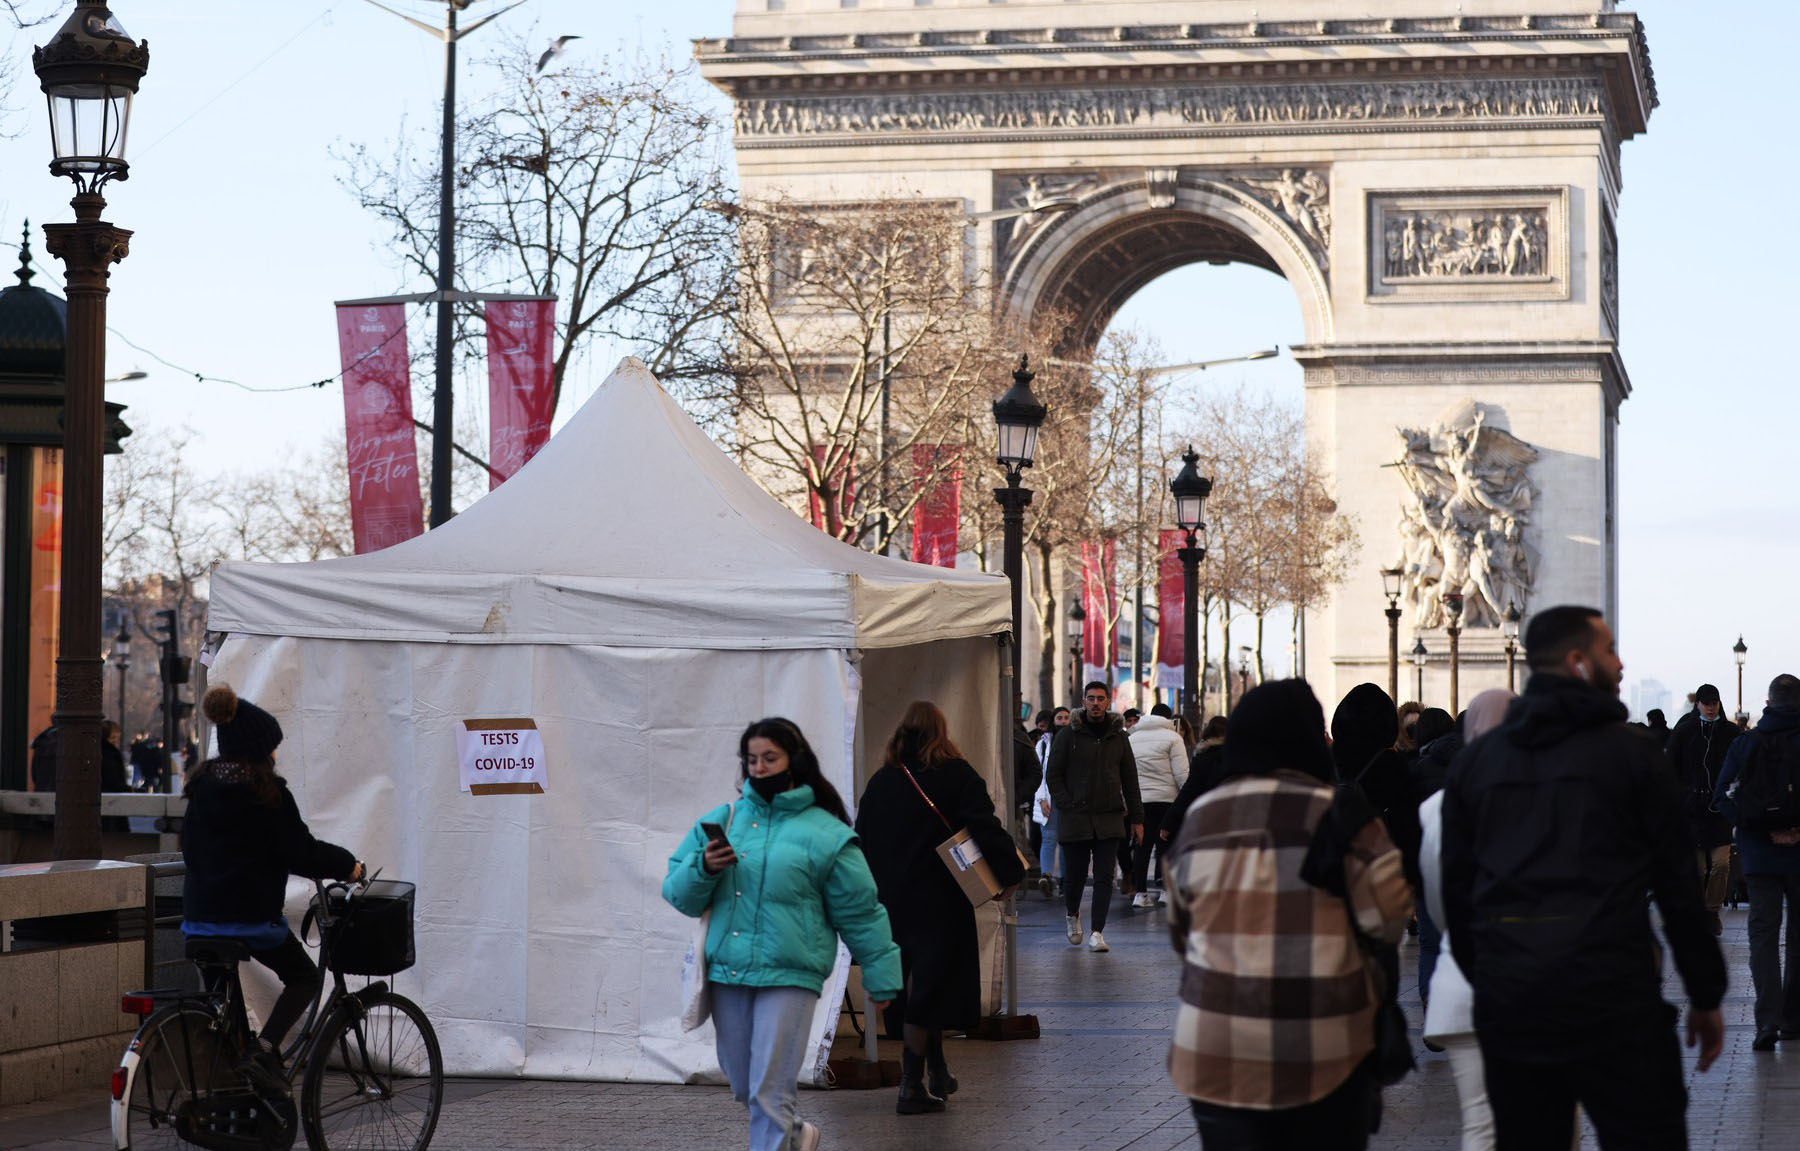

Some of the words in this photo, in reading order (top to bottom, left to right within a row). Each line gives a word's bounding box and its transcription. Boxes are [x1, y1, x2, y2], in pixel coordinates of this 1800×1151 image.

[360, 324, 386, 333] PARIS
[480, 732, 519, 745] TESTS
[475, 757, 535, 770] COVID-19
